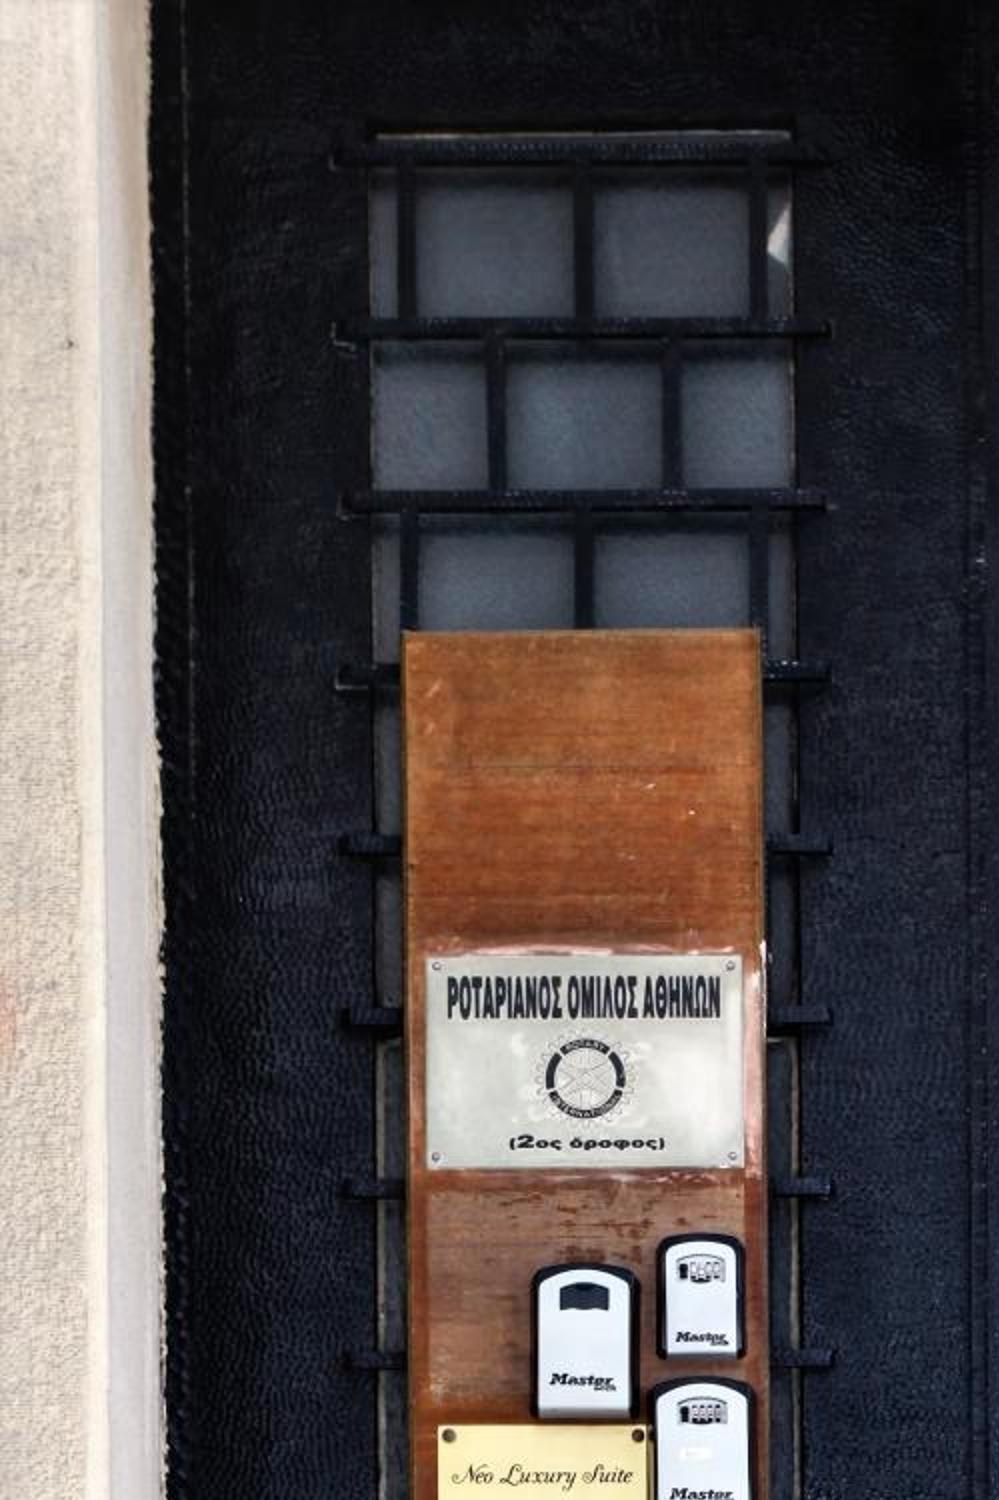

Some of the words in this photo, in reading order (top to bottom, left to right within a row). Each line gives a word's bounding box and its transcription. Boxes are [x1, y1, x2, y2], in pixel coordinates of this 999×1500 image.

[447, 975, 562, 1019] ΡΟΤΑΡΙΑΝΟΣ
[567, 975, 638, 1019] ΟΜΙΛΟΣ
[642, 975, 721, 1019] ΑΘΗΝΩΝ
[509, 1134, 562, 1151] (2ος
[569, 1136, 665, 1151] όροφος)
[675, 1331, 727, 1344] Master
[549, 1373, 614, 1386] Master
[451, 1463, 494, 1485] Neo
[499, 1463, 577, 1492] Luxury
[582, 1463, 633, 1485] Suite
[669, 1487, 733, 1500] Master
